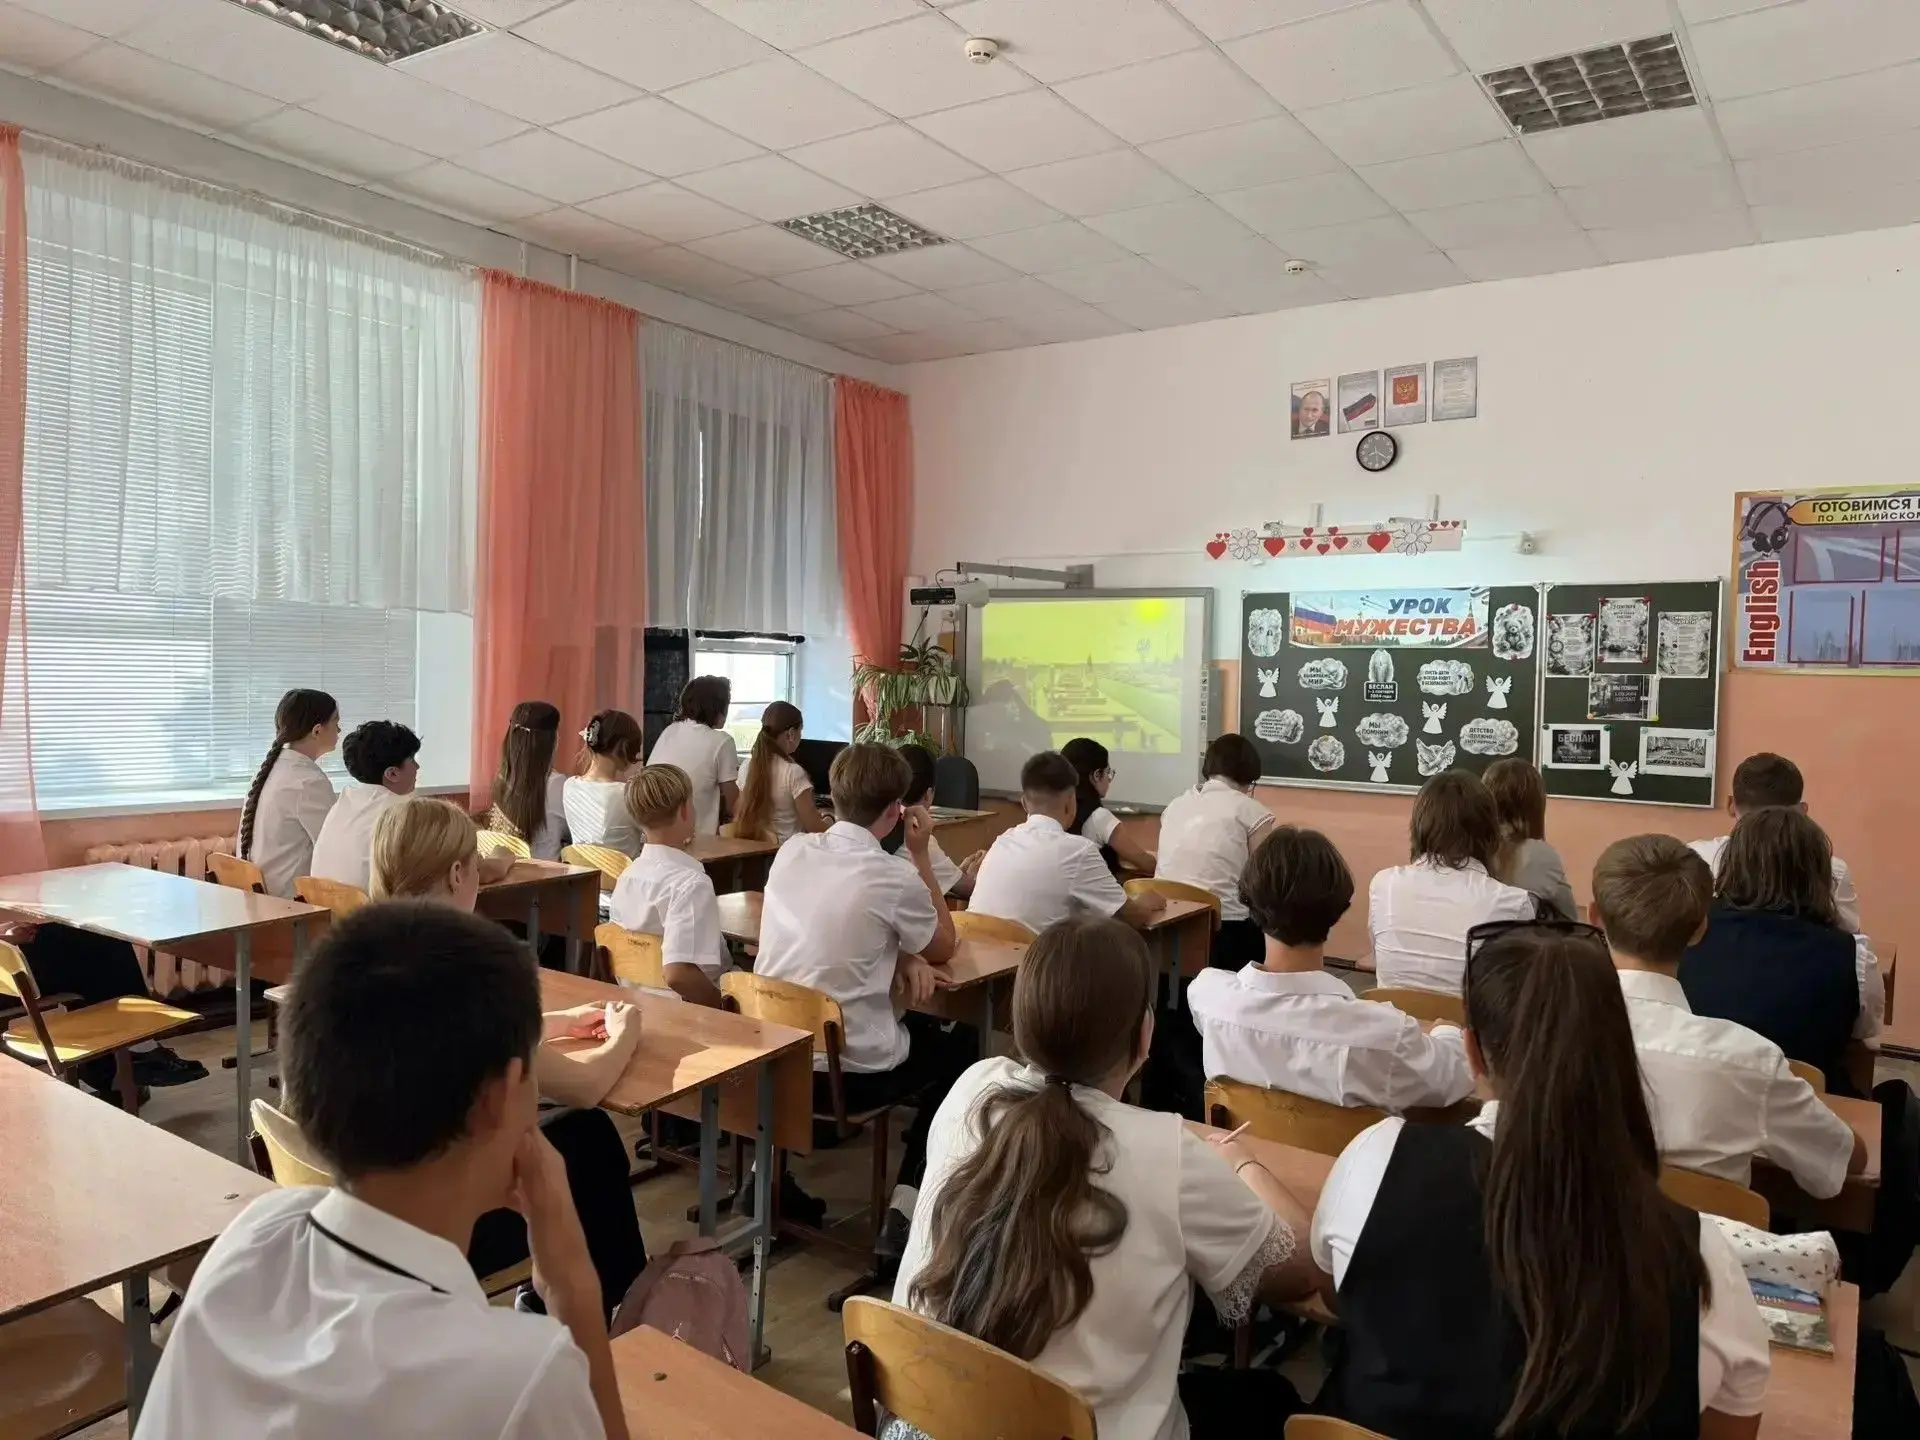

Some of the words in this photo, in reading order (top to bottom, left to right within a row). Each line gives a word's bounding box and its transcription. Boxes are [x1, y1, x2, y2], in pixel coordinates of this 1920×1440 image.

[1812, 498, 1911, 513] ГОТОВИМСЯ
[1817, 514, 1834, 522] ПО
[1387, 597, 1452, 614] УРОК
[1743, 560, 1781, 662] English
[1334, 616, 1477, 637] МУЖЕСТВА
[1557, 733, 1594, 743] БЕСЛАН
